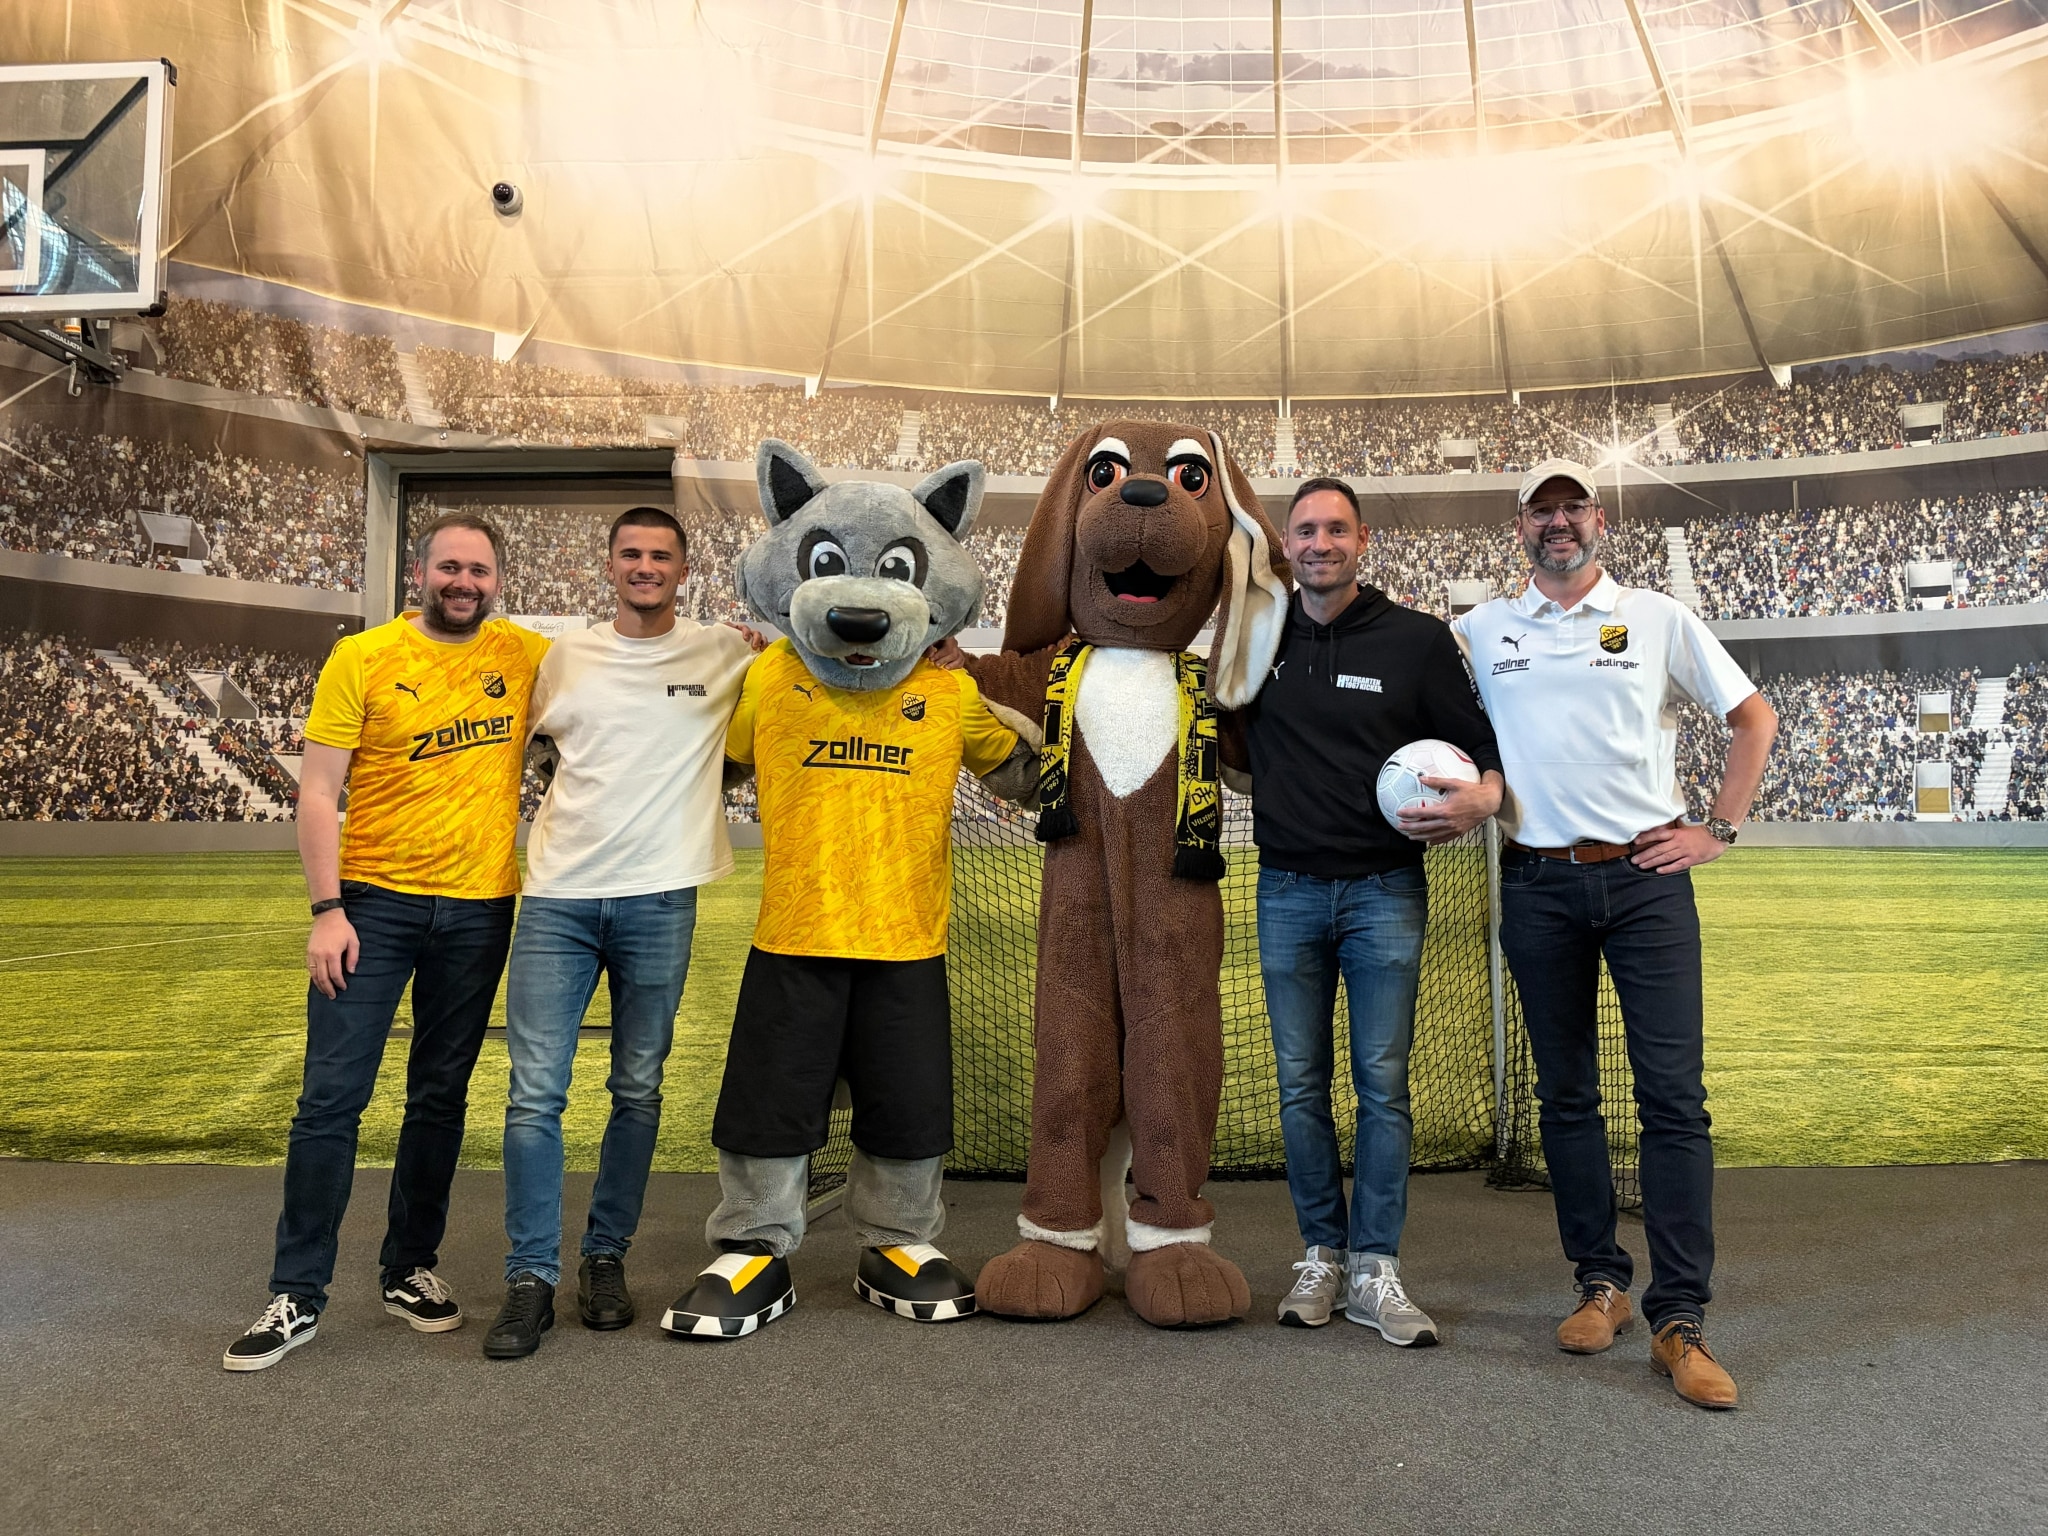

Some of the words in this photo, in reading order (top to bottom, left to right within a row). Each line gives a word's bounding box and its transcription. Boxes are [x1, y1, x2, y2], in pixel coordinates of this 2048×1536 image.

[1590, 658, 1640, 670] rädlinger
[1046, 777, 1059, 791] 1967
[1192, 784, 1216, 805] DJK
